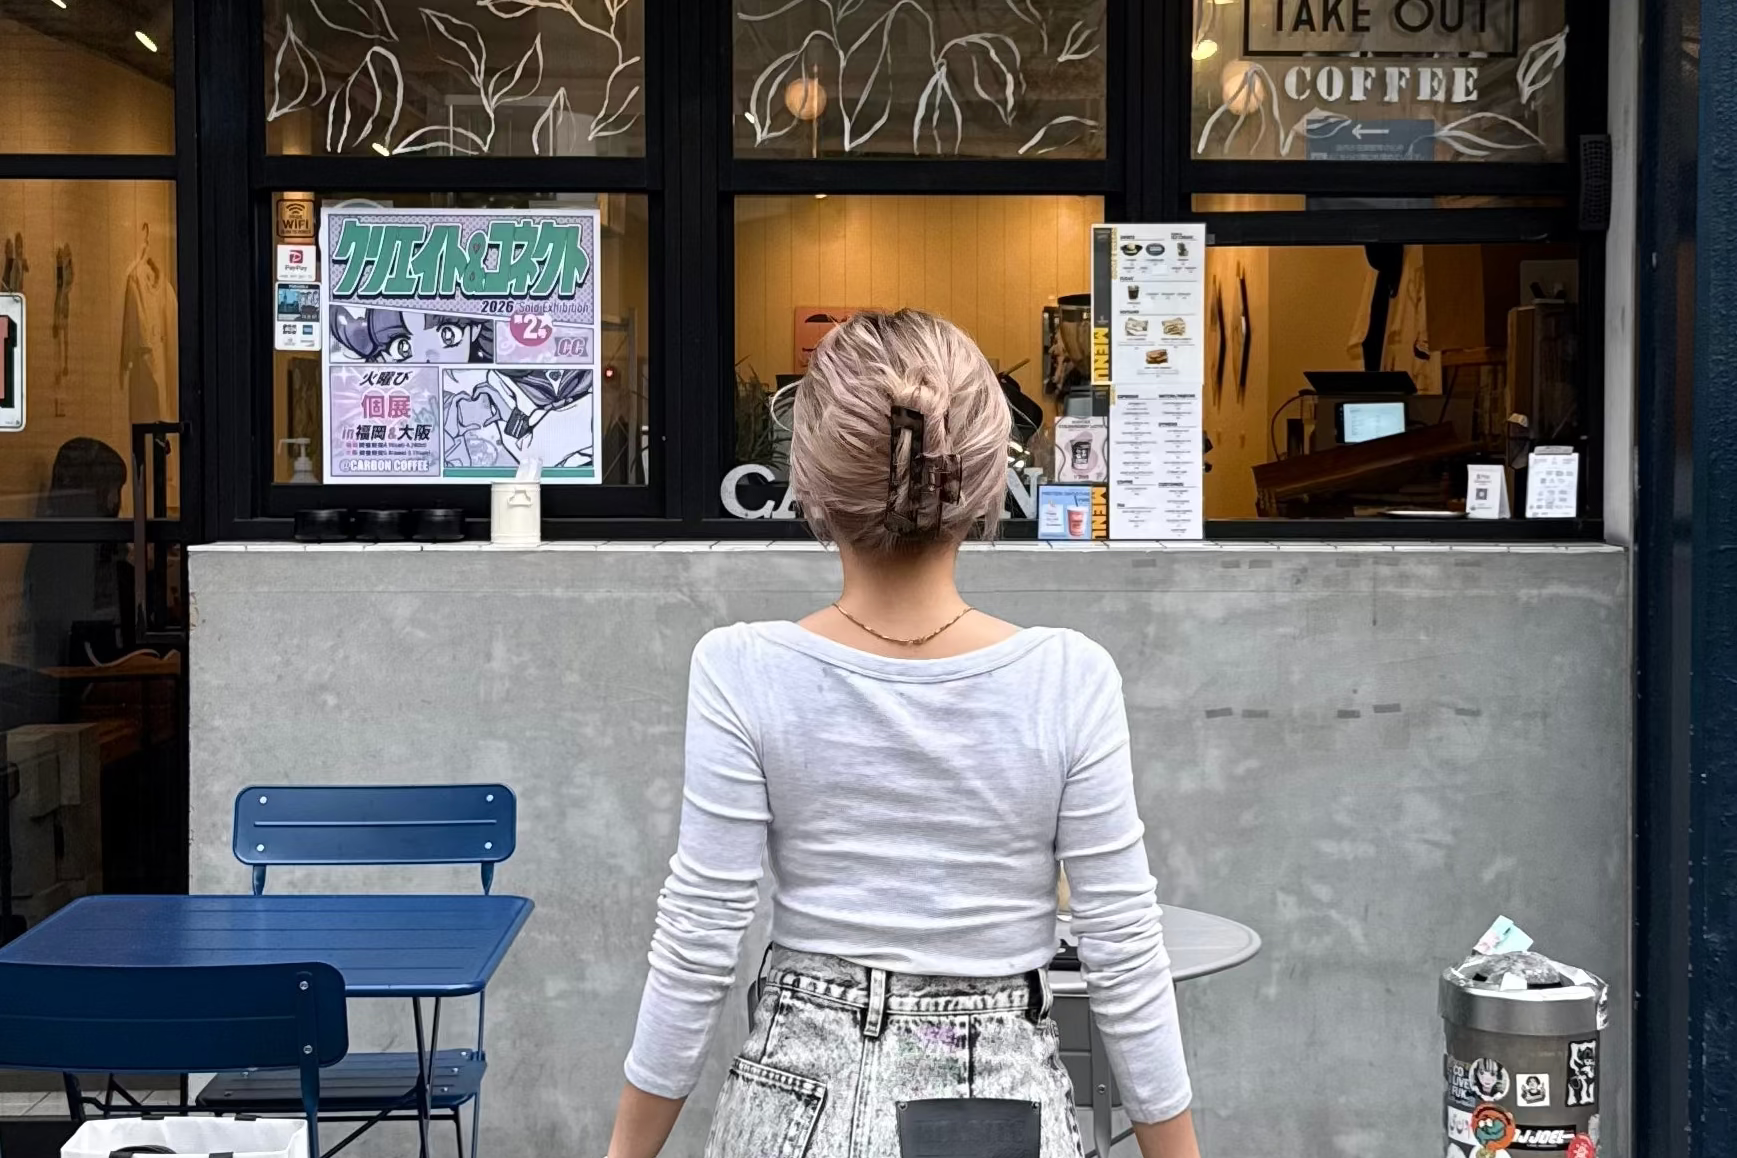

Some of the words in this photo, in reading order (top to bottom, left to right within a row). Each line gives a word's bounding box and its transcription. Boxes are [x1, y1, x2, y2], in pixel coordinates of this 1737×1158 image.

[1275, 0, 1372, 32] TAKE
[1394, 0, 1488, 32] OUT
[1284, 66, 1478, 102] COFFEE
[284, 263, 308, 273] PayPay
[481, 300, 514, 313] 2026
[360, 371, 412, 386] 火曜び
[361, 394, 411, 419] 個展
